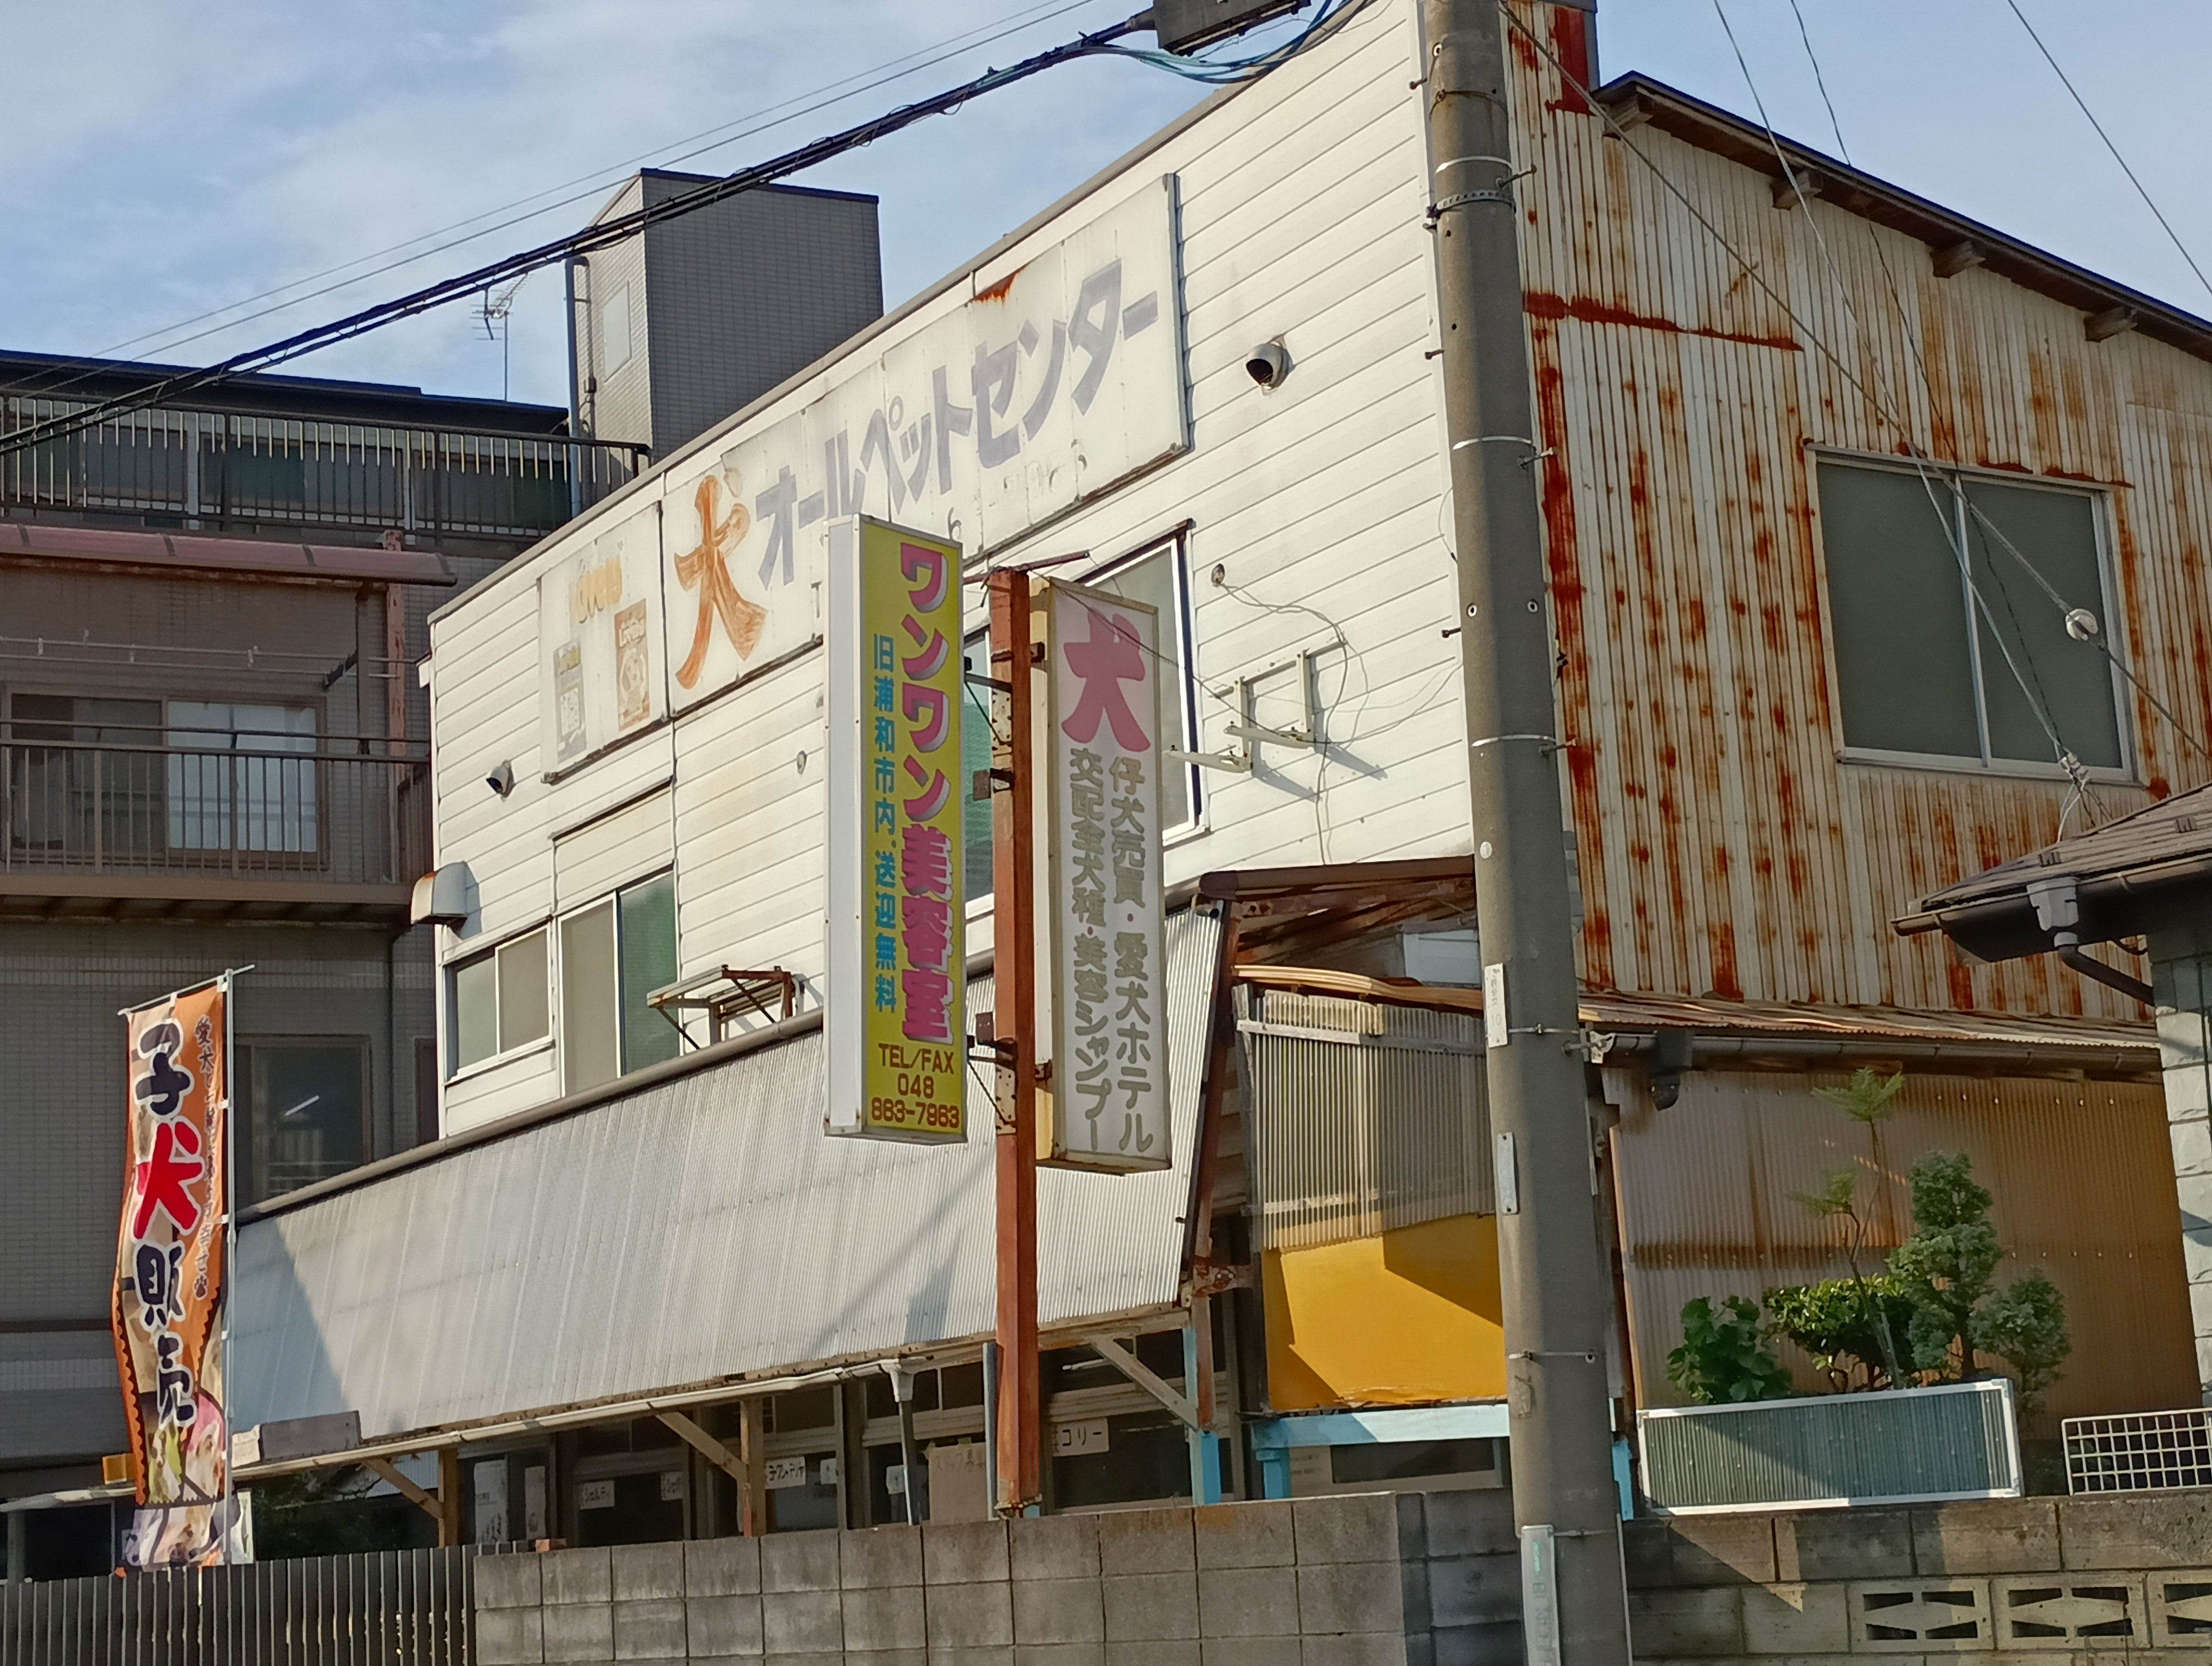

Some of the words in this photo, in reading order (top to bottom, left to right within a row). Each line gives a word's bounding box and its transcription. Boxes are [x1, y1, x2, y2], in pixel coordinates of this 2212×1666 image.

[755, 258, 1159, 591] オールペットセンター
[1060, 607, 1151, 752] 犬
[900, 542, 954, 1046] ワンワン美容室
[878, 1043, 954, 1074] TEL/FAX
[898, 1073, 934, 1099] 048
[1062, 1427, 1102, 1446] コリー
